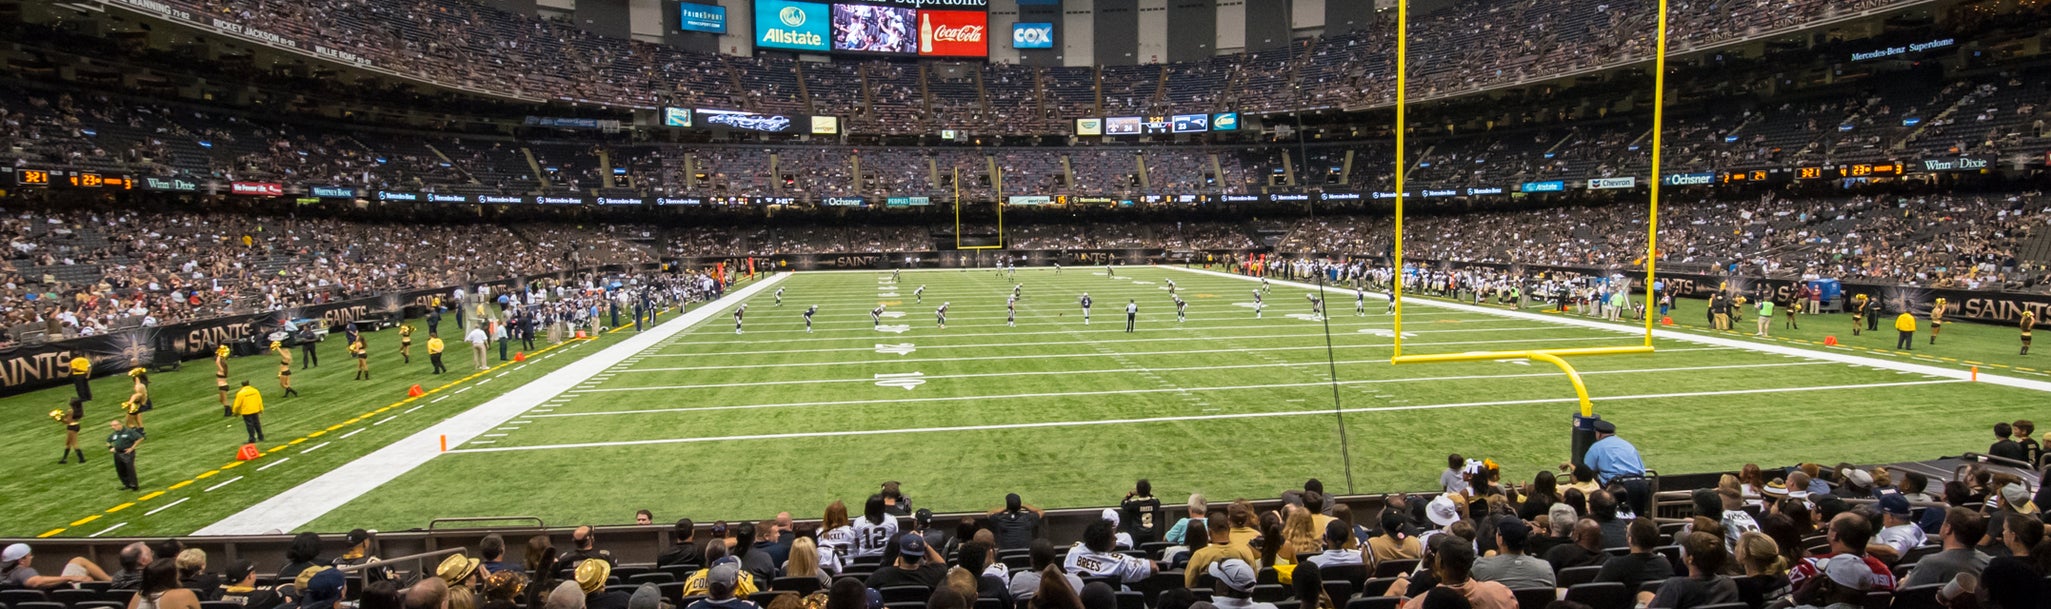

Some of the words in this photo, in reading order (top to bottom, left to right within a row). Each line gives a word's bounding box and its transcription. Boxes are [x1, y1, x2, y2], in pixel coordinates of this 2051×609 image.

[132, 0, 172, 15] MANNING
[213, 18, 242, 33] RICKEY
[244, 27, 279, 43] JACKSON
[763, 28, 824, 46] Allstate
[934, 24, 983, 42] Coca-Cola
[1013, 28, 1050, 43] COX
[315, 45, 338, 58] WILLIE
[1851, 45, 1906, 62] Mercedes-Benz
[1909, 37, 1954, 52] Superdome
[1895, 164, 1902, 175] 3
[1925, 159, 1950, 170] Winn
[1959, 157, 1987, 169] Dixie
[124, 179, 132, 190] 3
[147, 177, 169, 189] Winn
[175, 180, 195, 191] Dixie
[1602, 179, 1631, 187] Chevron
[1671, 174, 1711, 185] Ochsner
[313, 187, 337, 196] WHITNEY
[337, 188, 352, 196] BANK
[828, 197, 861, 206] Ochsner
[837, 256, 879, 267] SAINTS
[189, 322, 252, 352] SAINTS
[0, 351, 71, 387] AINTS
[863, 527, 887, 549] 12
[1076, 555, 1102, 572] BREES
[1788, 567, 1805, 585] 87
